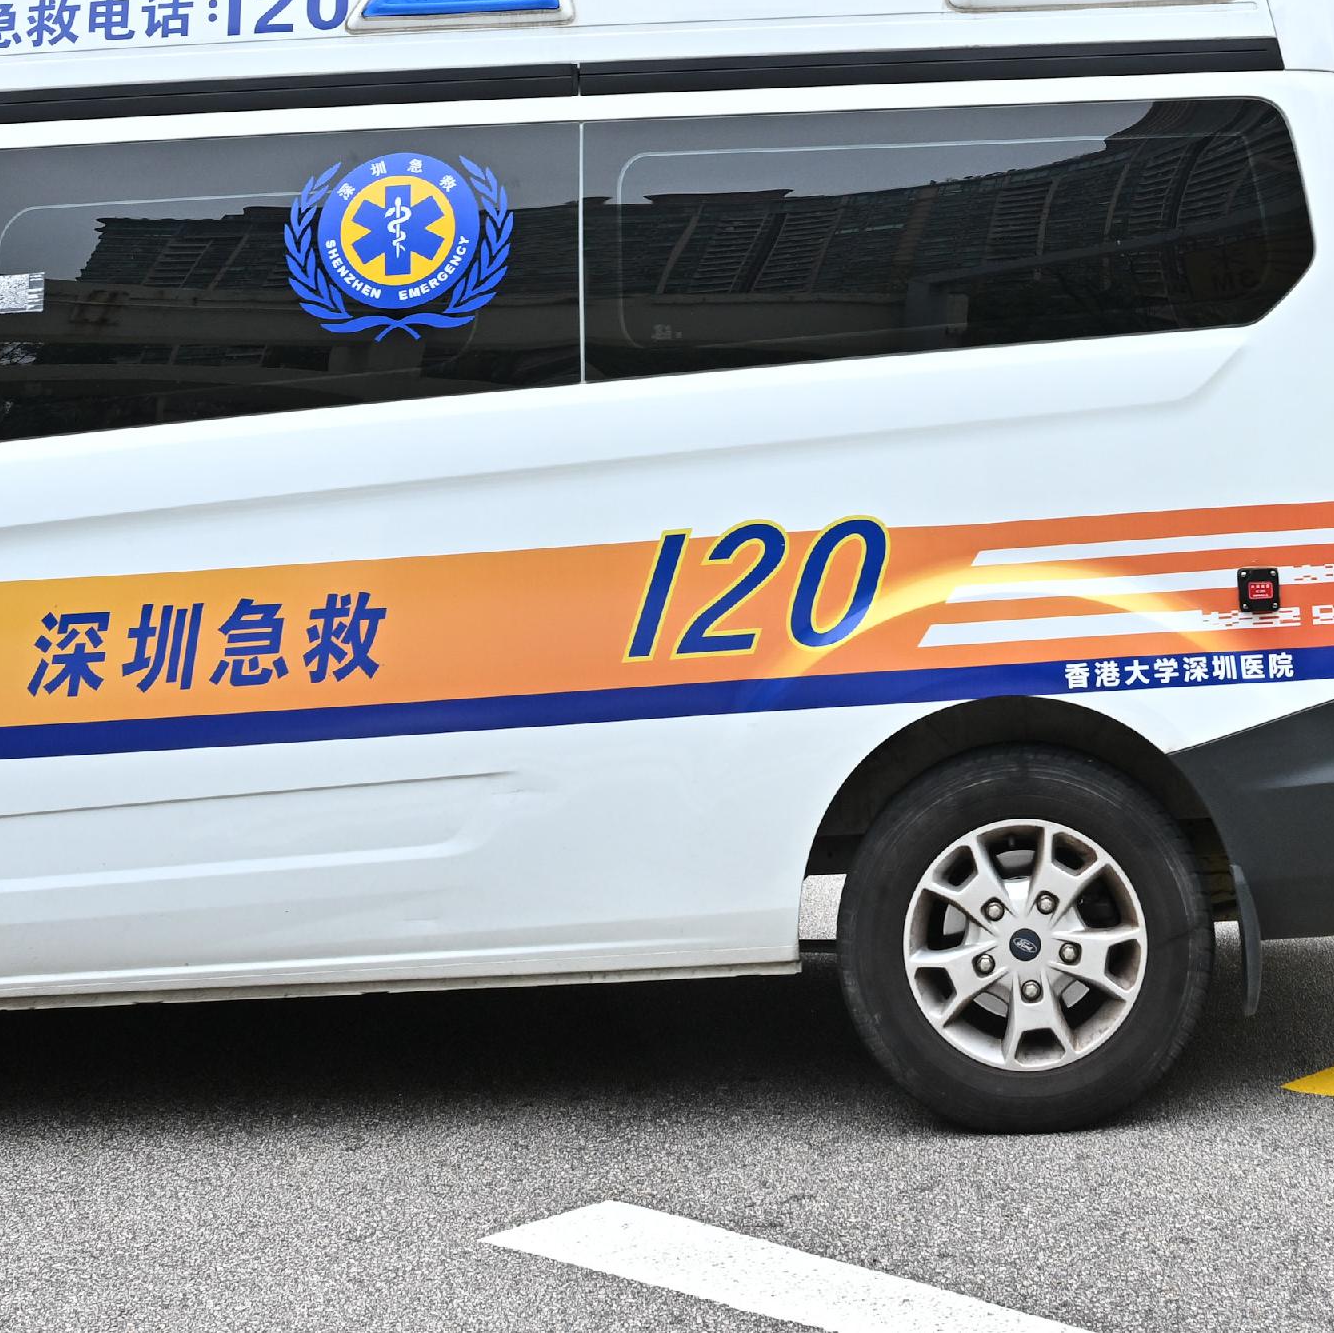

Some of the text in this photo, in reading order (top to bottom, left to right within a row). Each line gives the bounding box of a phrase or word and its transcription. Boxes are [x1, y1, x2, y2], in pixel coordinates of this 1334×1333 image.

[337, 158, 457, 200] 深圳急救
[325, 235, 470, 301] SHENZHEN EMERGENCY
[622, 515, 891, 662] 120
[26, 591, 387, 698] 深圳急救
[1064, 651, 1295, 690] 香港大学深圳医院
